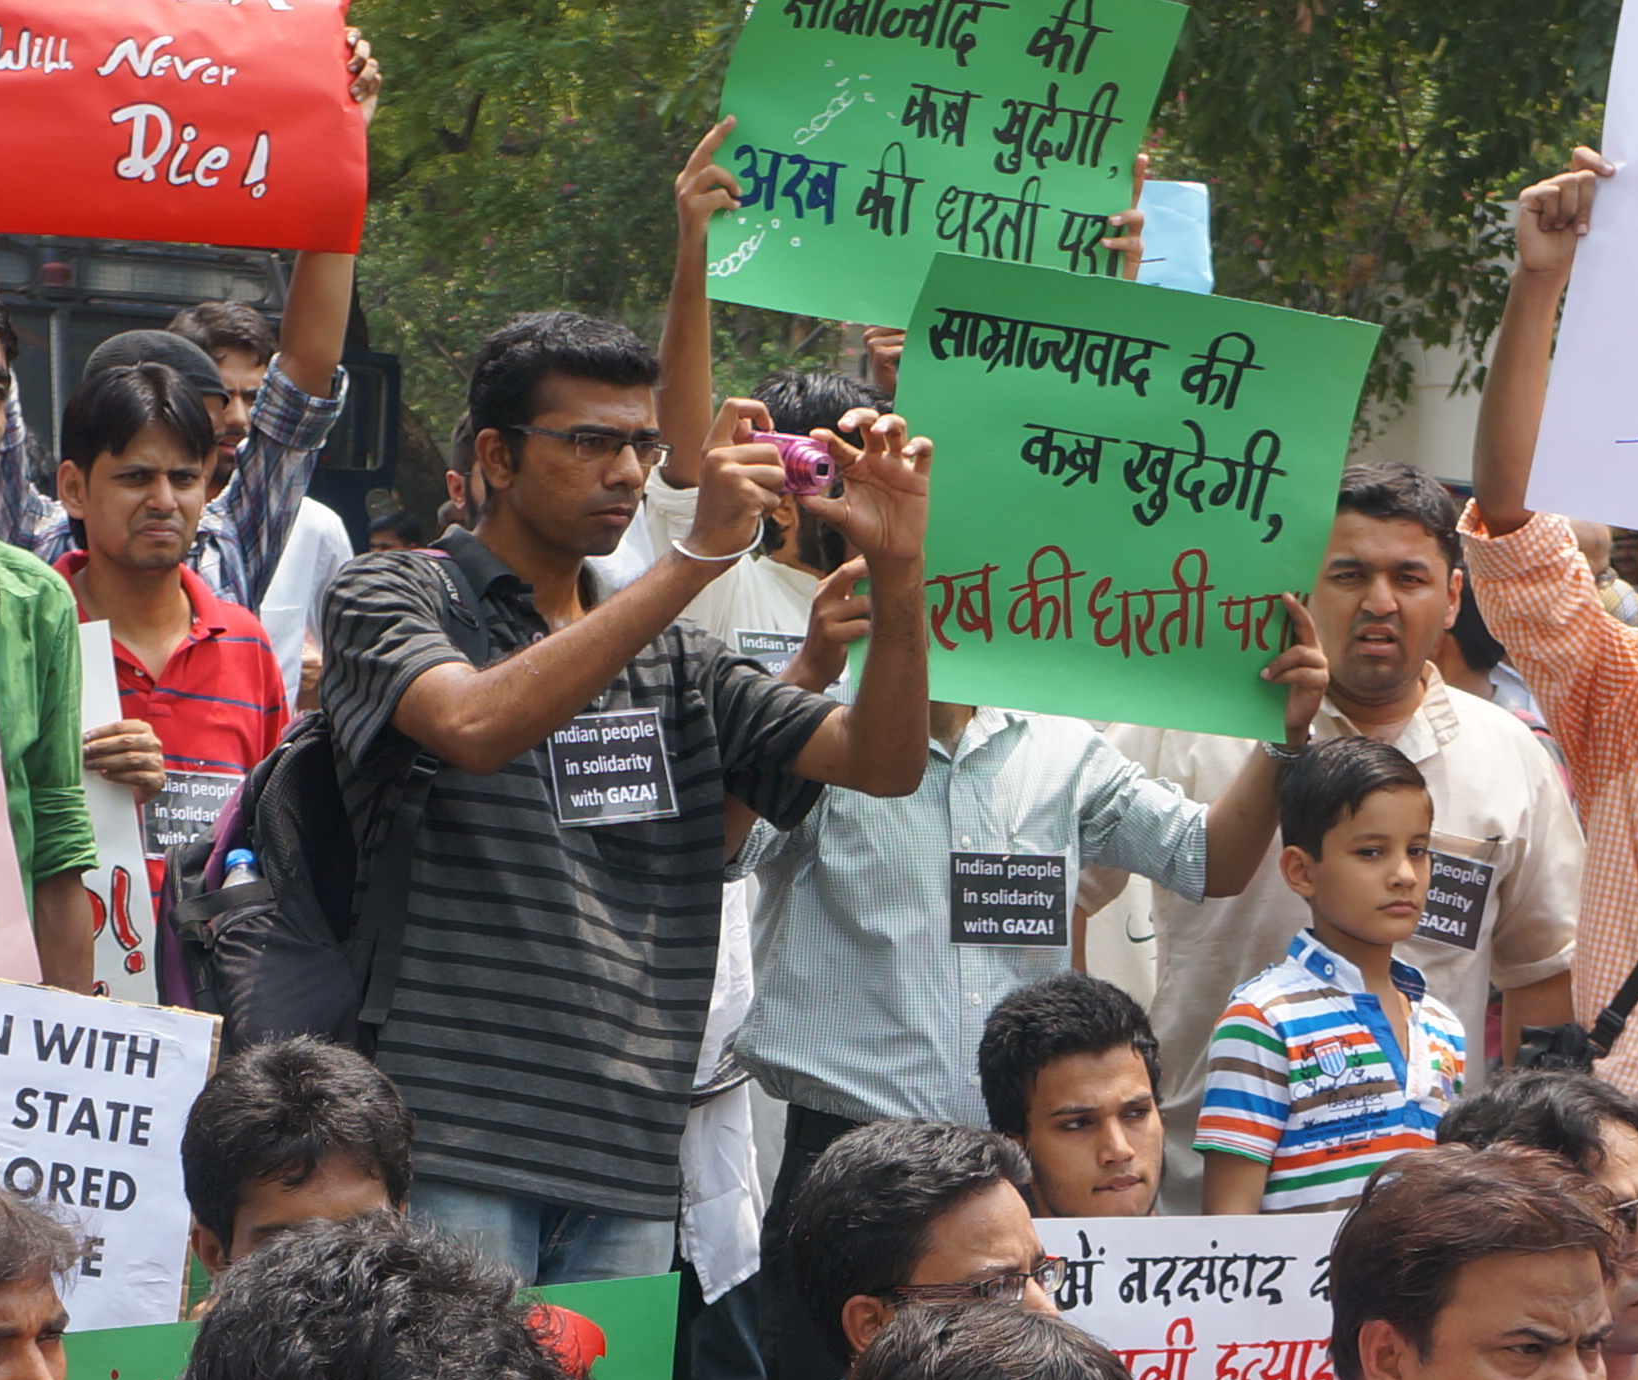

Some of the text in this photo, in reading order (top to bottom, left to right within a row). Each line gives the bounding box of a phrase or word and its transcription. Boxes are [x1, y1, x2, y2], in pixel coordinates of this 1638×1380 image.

[97, 35, 237, 87] Never
[733, 142, 1049, 263] अरब की धरती
[1180, 331, 1265, 411] की
[1021, 420, 1288, 543] कब्र खुदेगी,
[926, 545, 1216, 659] रब की धरती
[601, 721, 654, 746] people
[565, 753, 652, 776] in solidarity
[570, 783, 659, 807] with GAZA!
[955, 859, 1062, 880] Indian people
[1432, 859, 1487, 886] people
[963, 887, 1055, 908] in solidarity
[963, 917, 1054, 935] with GAZA!
[33, 1020, 160, 1079] WITH
[11, 1087, 154, 1147] STATE
